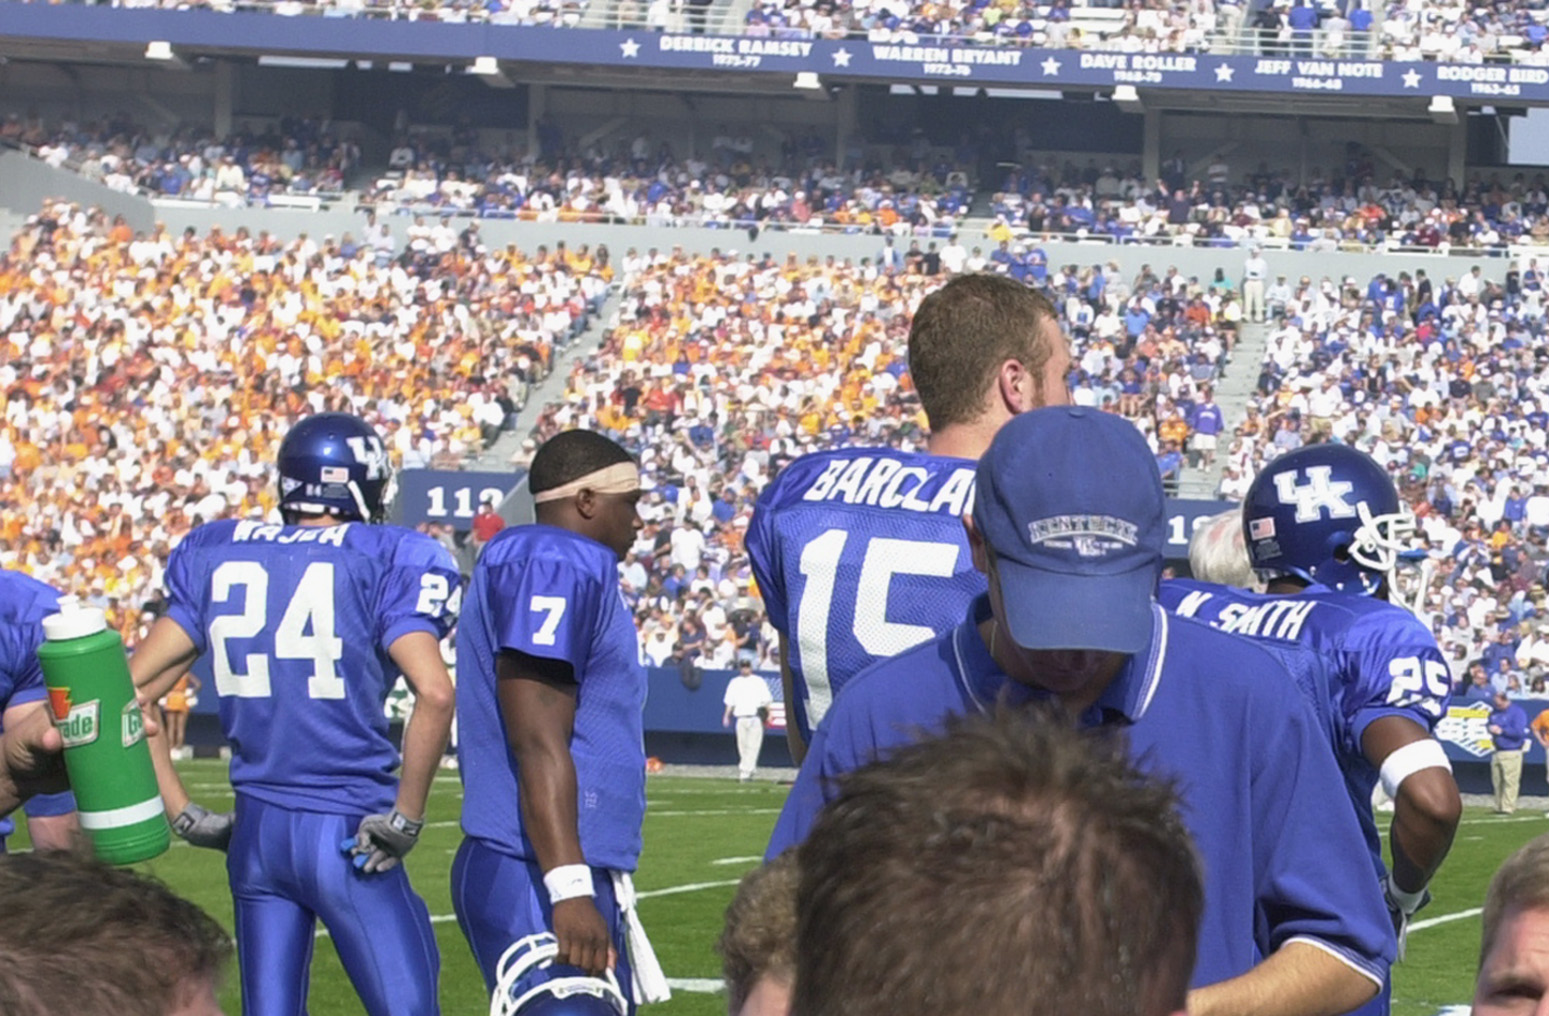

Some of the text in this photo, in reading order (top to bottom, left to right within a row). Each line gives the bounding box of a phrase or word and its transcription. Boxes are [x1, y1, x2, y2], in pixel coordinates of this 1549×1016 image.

[659, 36, 813, 58] DERRICK RAMSEY
[873, 46, 1022, 66] WARREN BRYANT
[1080, 54, 1197, 72] DAVE ROLLER
[1254, 60, 1383, 78] JEFF VAN NOTE
[1437, 66, 1549, 85] RODGER BIRD
[1273, 466, 1356, 524] UK
[209, 561, 346, 699] 24
[531, 596, 567, 646] 7
[798, 528, 960, 731] 15
